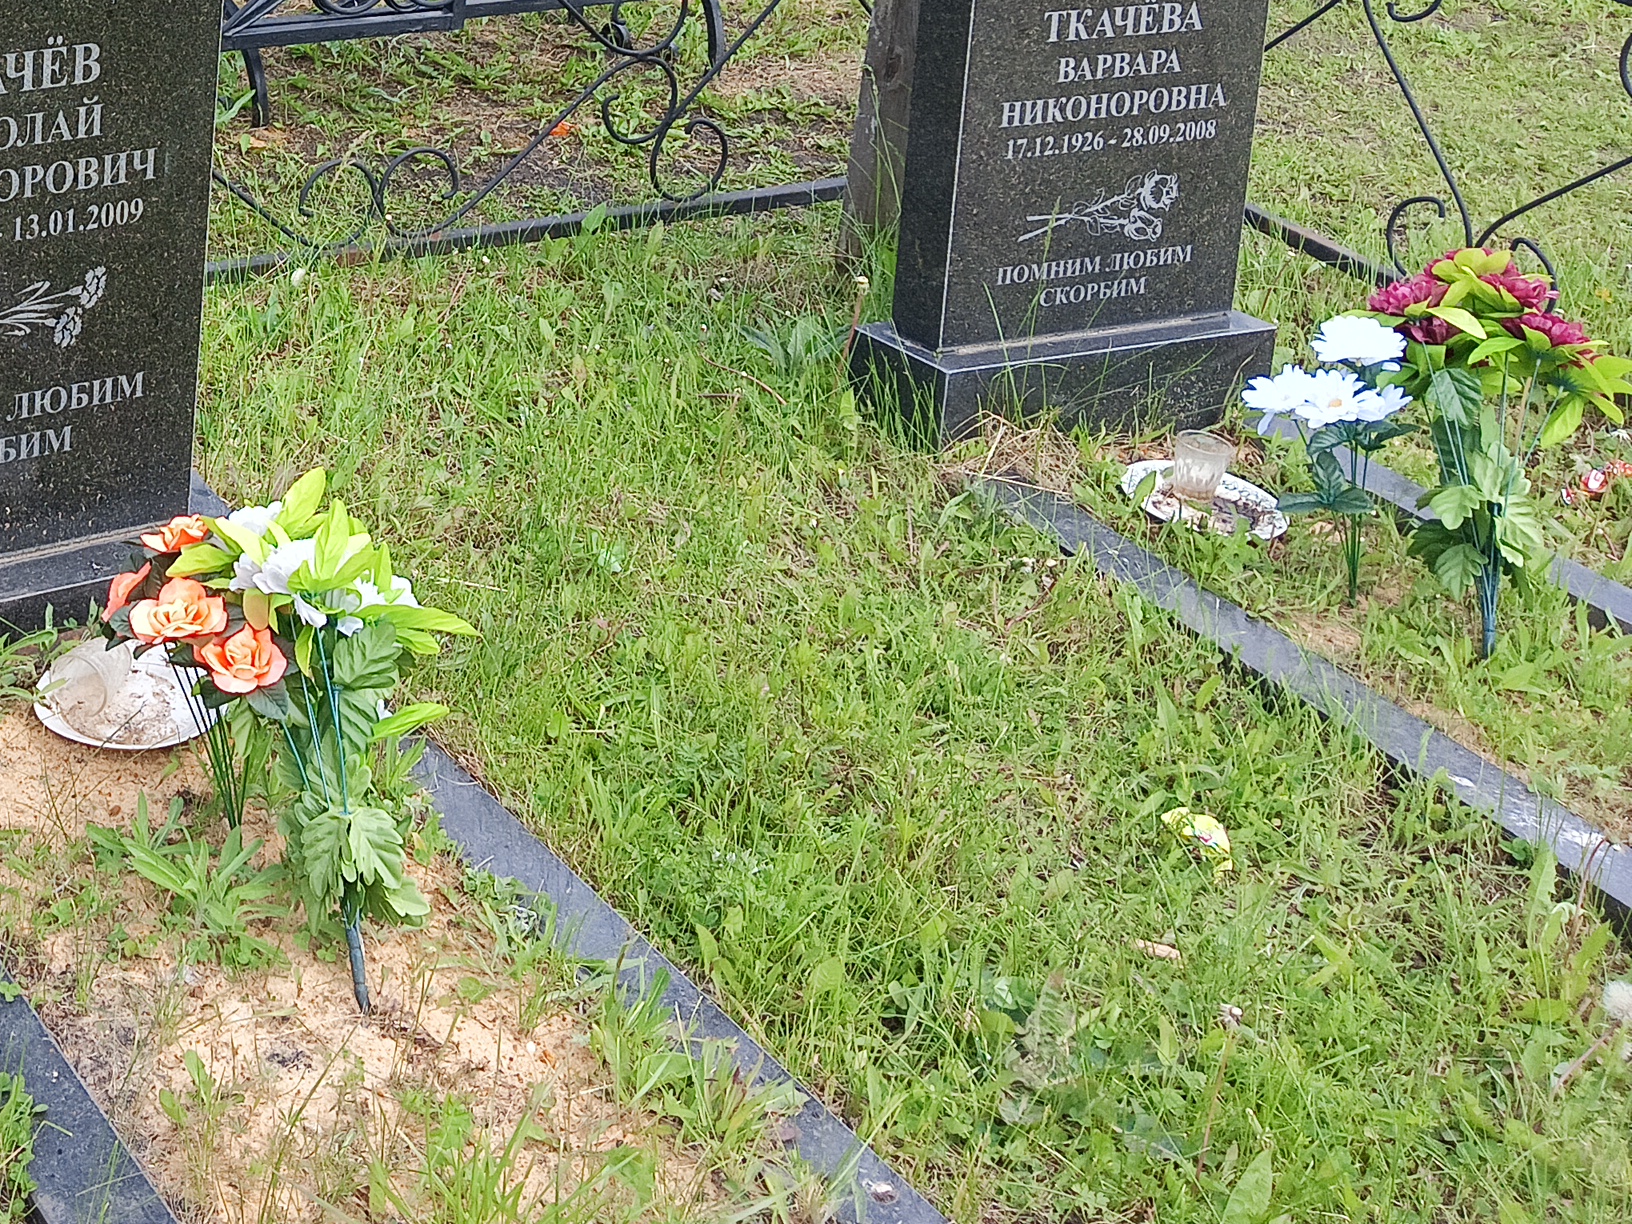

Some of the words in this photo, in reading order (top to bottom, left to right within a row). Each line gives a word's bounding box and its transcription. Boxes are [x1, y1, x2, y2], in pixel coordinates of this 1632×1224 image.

[1057, 46, 1182, 83] ВАРВАРА
[998, 82, 1227, 128] НИКОНОРОВНА
[1004, 130, 1104, 160] 17.12.1926
[1121, 120, 1217, 148] 28.09.2008
[14, 198, 145, 242] 13.01.2009
[996, 254, 1102, 286] ПОМНИМ
[1106, 244, 1193, 273] ЛЮБИМ
[1039, 277, 1147, 308] СКОРБИМ
[6, 370, 145, 423] ЛЮБИМ
